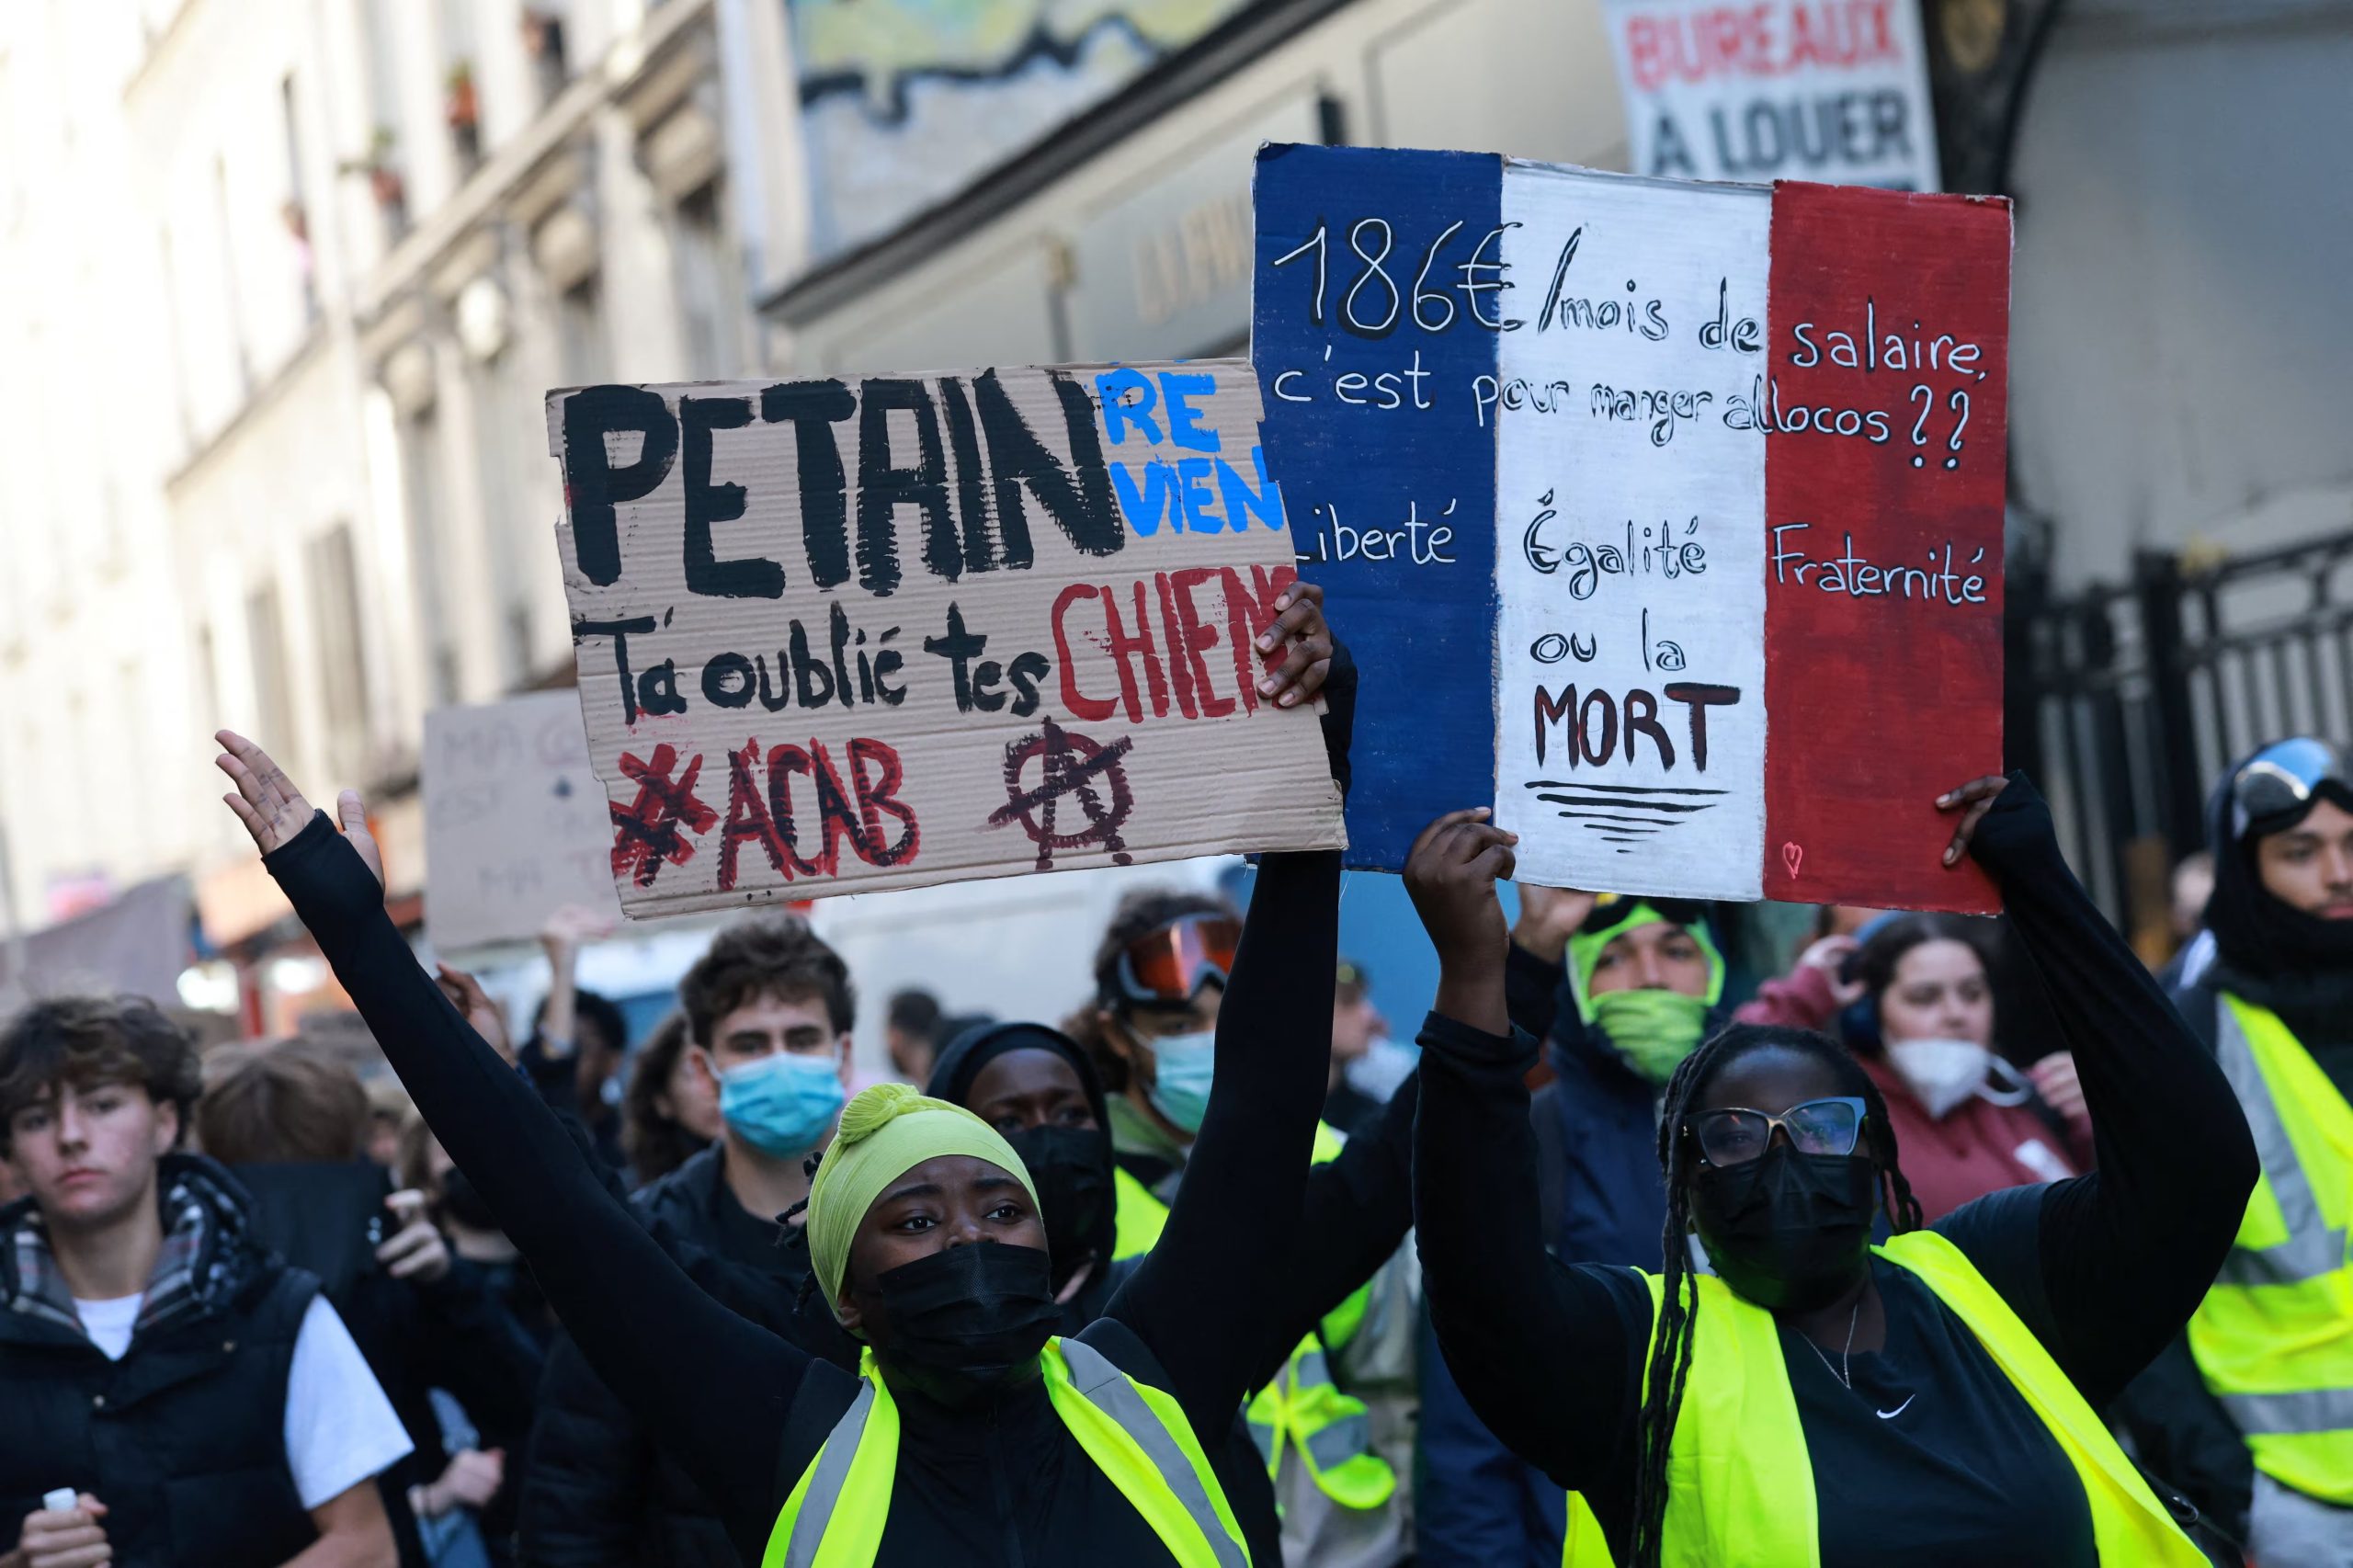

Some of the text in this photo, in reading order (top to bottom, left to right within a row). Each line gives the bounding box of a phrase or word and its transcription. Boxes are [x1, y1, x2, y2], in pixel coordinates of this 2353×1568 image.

[1626, 0, 1901, 92] BUREAUX
[1708, 88, 1914, 176] LOUER
[1699, 277, 1765, 356] de
[1790, 295, 1991, 384] salaire,
[1095, 368, 1222, 453] RE
[1274, 344, 1432, 410] c'est
[1472, 374, 1570, 426] pour
[1590, 381, 1712, 448] manger
[1722, 373, 1892, 441] allocos
[563, 367, 1125, 599] PETAIN
[1108, 446, 1284, 539] VIEN
[1295, 497, 1458, 564] iberté
[1522, 487, 1707, 601] Égalité
[1772, 521, 1987, 606] Fraternité
[700, 599, 908, 712] oublié
[924, 600, 1051, 718] tes
[1529, 608, 1687, 671] ou la
[1535, 681, 1741, 773] MORT
[717, 736, 920, 892] ACAB
